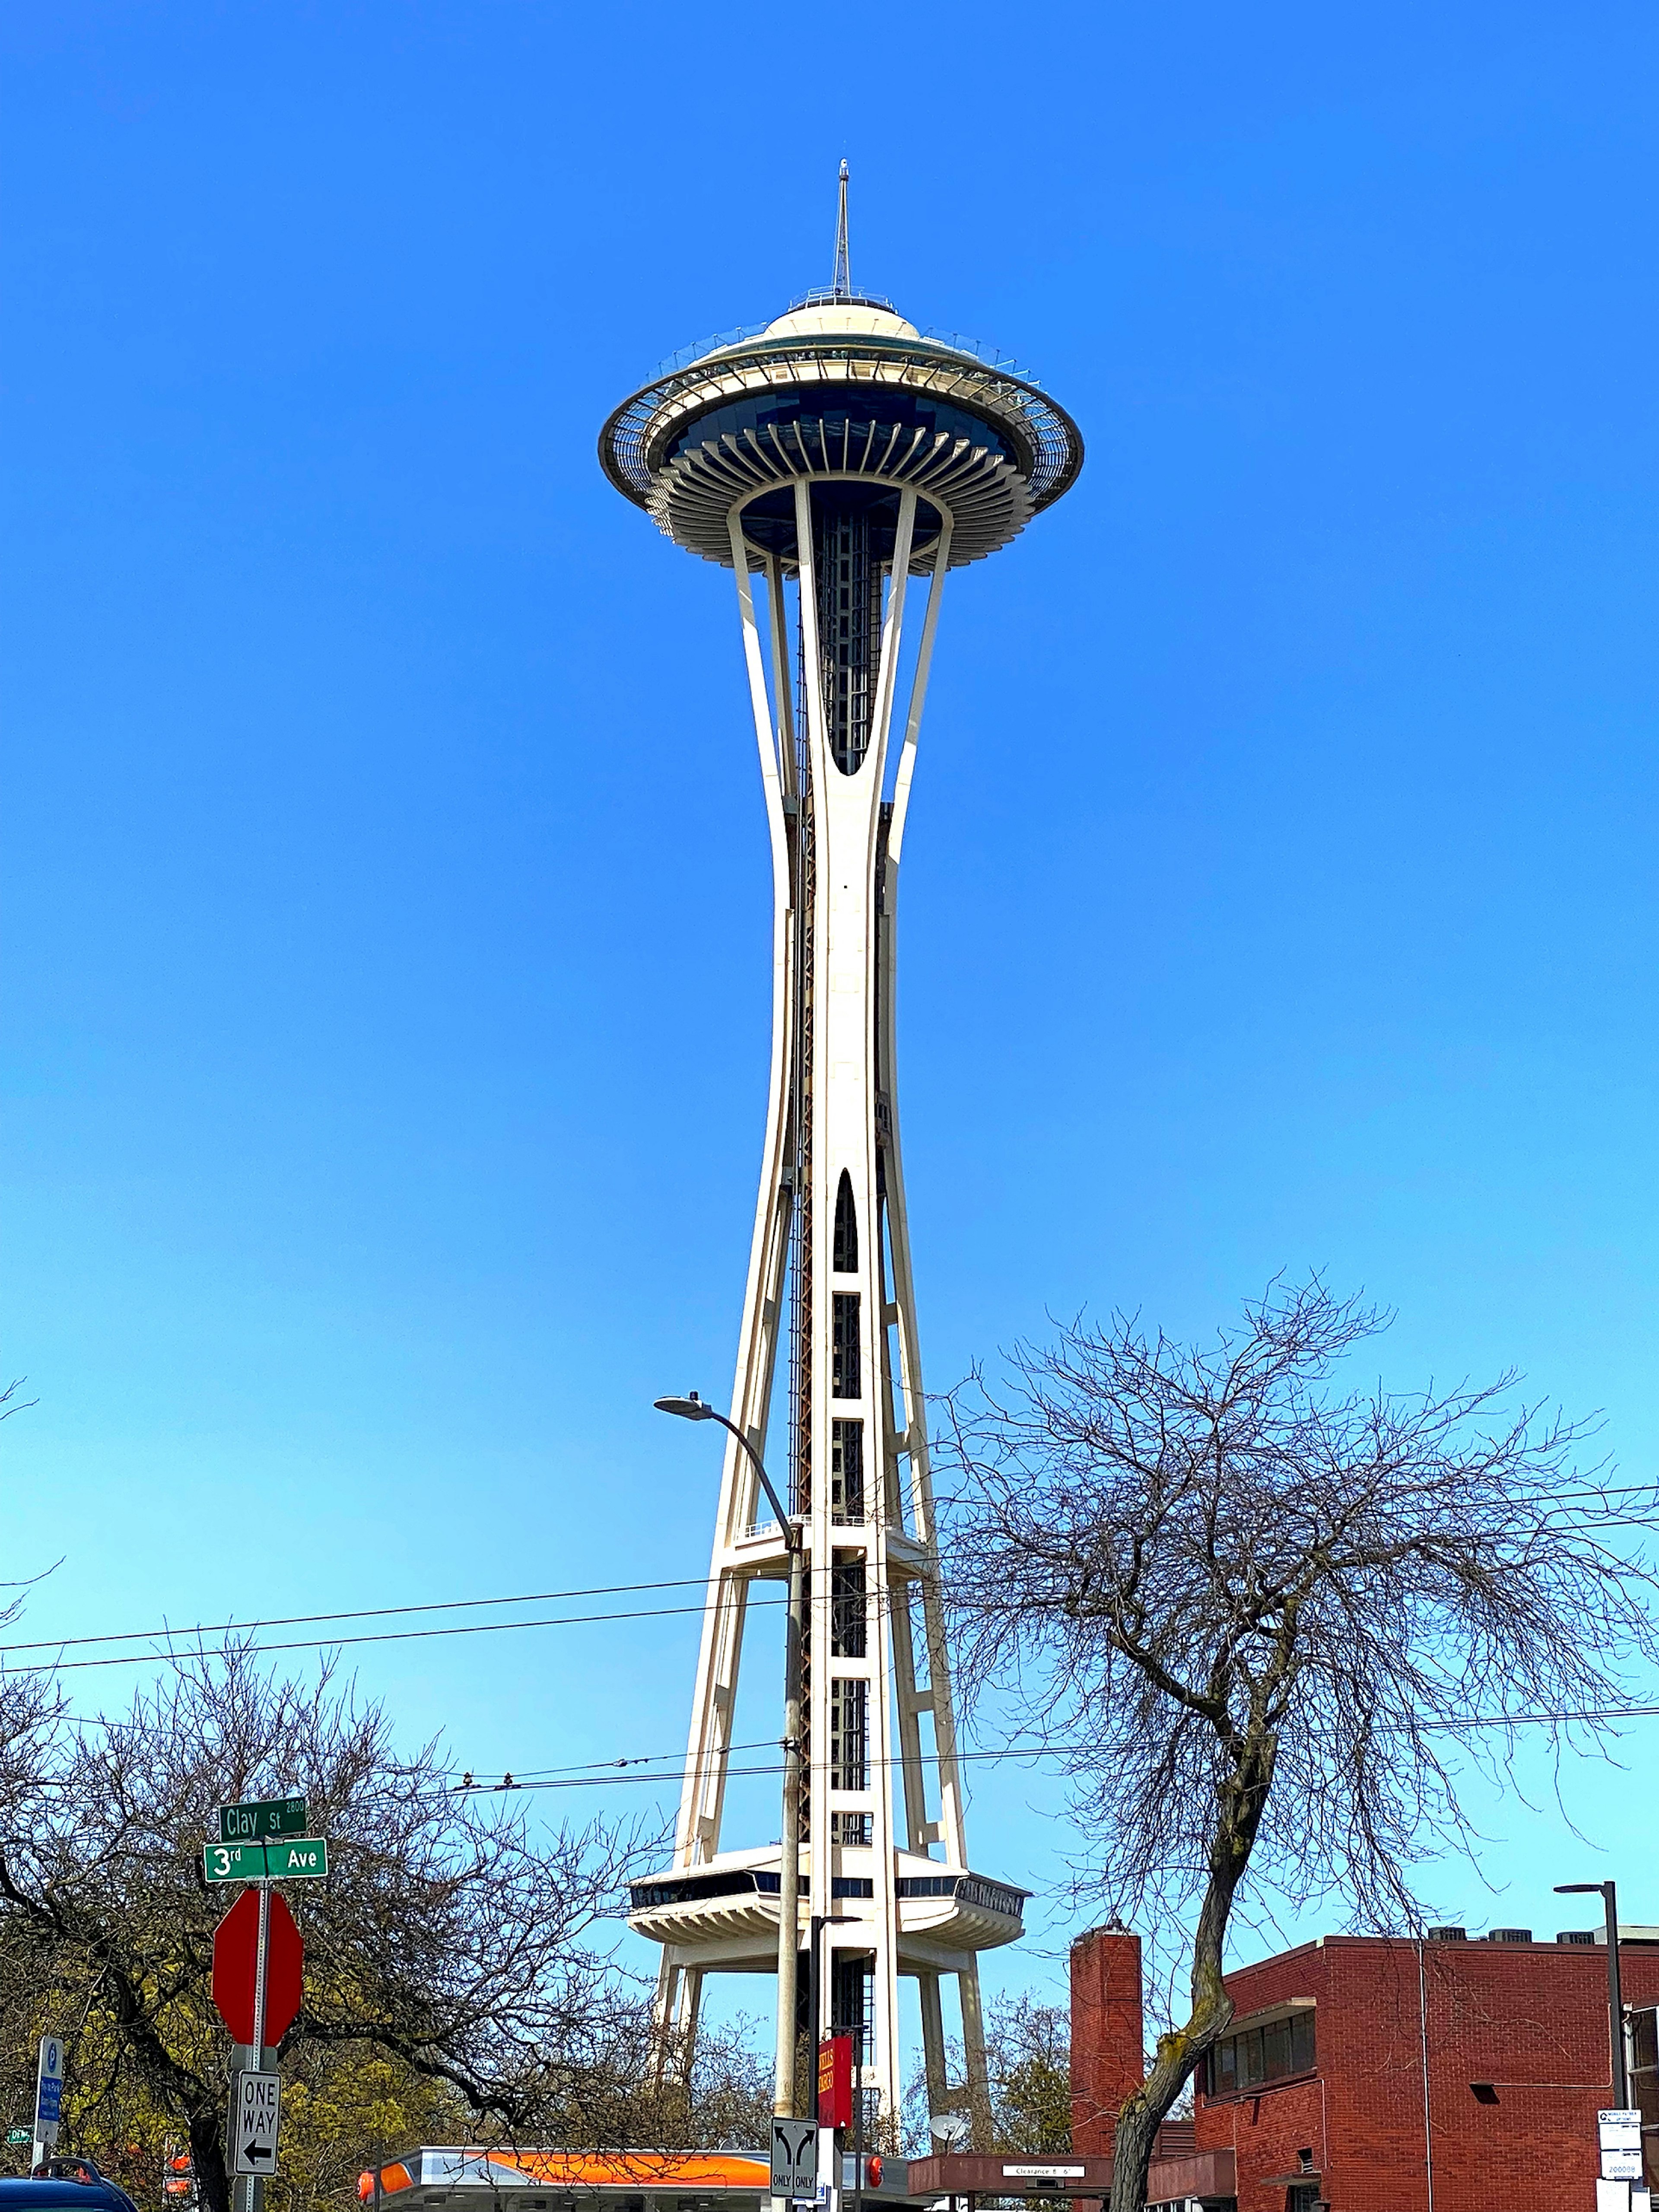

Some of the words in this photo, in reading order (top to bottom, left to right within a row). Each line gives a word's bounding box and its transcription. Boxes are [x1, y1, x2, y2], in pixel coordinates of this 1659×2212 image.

[286, 1800, 304, 1813] 2800
[227, 1808, 257, 1836] Clay
[270, 1812, 280, 1830] St
[213, 1847, 242, 1876] 3rd
[288, 1849, 317, 1868] Ave
[245, 2081, 275, 2106] ONE
[244, 2110, 275, 2134] WAY
[773, 2174, 791, 2187] ONLY
[795, 2176, 814, 2188] ONLY
